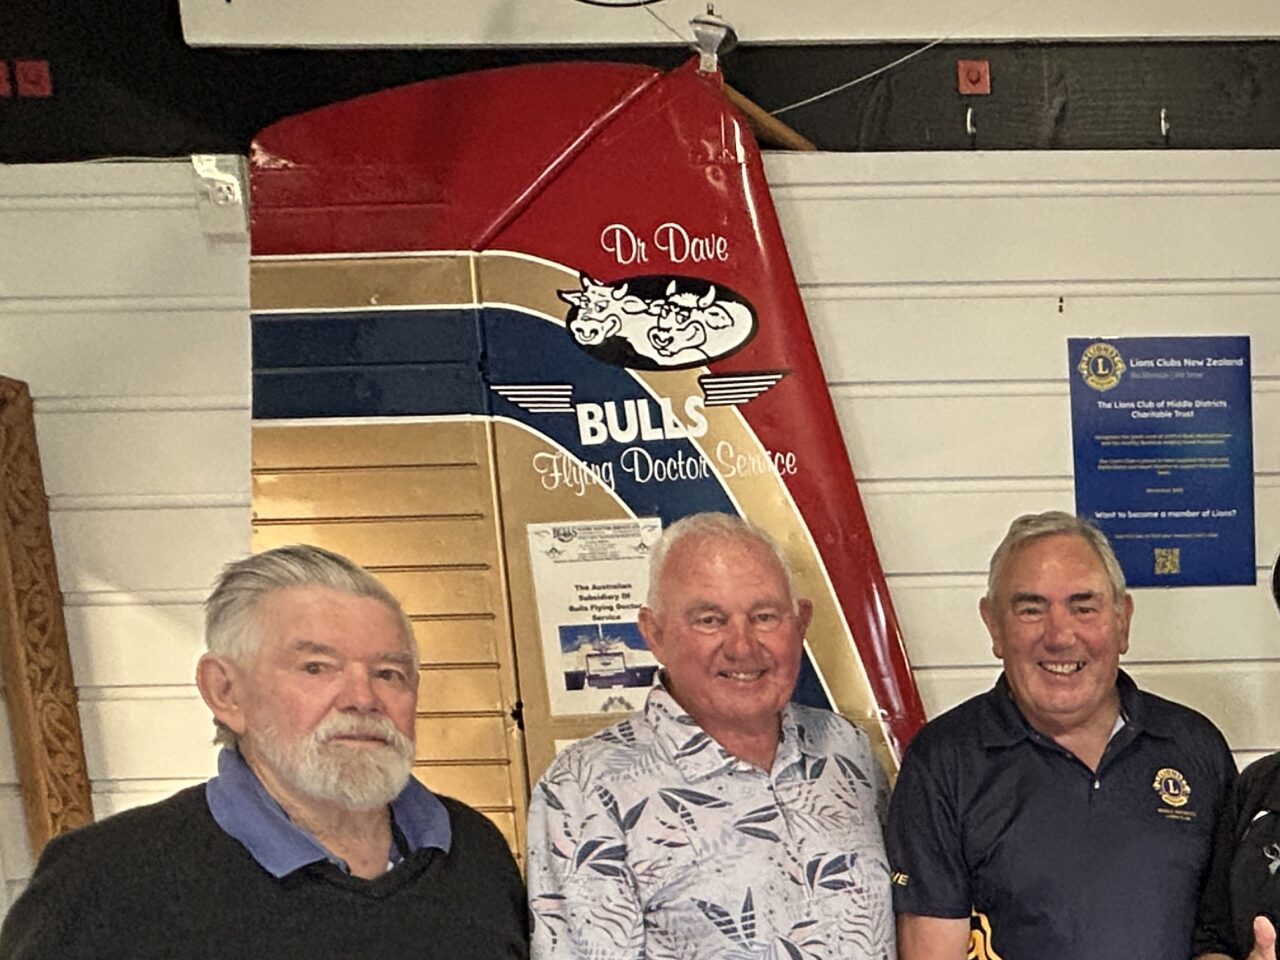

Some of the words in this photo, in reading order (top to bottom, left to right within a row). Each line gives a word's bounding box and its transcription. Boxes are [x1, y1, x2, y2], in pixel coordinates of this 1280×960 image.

[601, 223, 649, 264] Dr
[654, 222, 729, 263] Dave
[1130, 358, 1154, 368] Lions
[1156, 358, 1182, 367] Clubs
[1184, 357, 1204, 367] New
[1206, 357, 1244, 367] Zealand
[1097, 401, 1112, 409] The
[1114, 401, 1135, 409] Lions
[1137, 401, 1154, 409] Club
[1156, 400, 1165, 408] of
[1167, 400, 1193, 408] Middle
[1195, 400, 1227, 408] Districts
[1131, 410, 1172, 418] Charitable
[1174, 410, 1194, 418] Trust
[576, 396, 709, 445] BULLS
[533, 452, 615, 497] Flying
[620, 447, 710, 483] Doctor
[715, 440, 798, 479] Service
[1095, 510, 1115, 518] Want
[1118, 510, 1126, 518] to
[1128, 510, 1158, 518] become
[1168, 509, 1199, 518] member
[1202, 509, 1210, 517] of
[1212, 509, 1237, 517] Lions?
